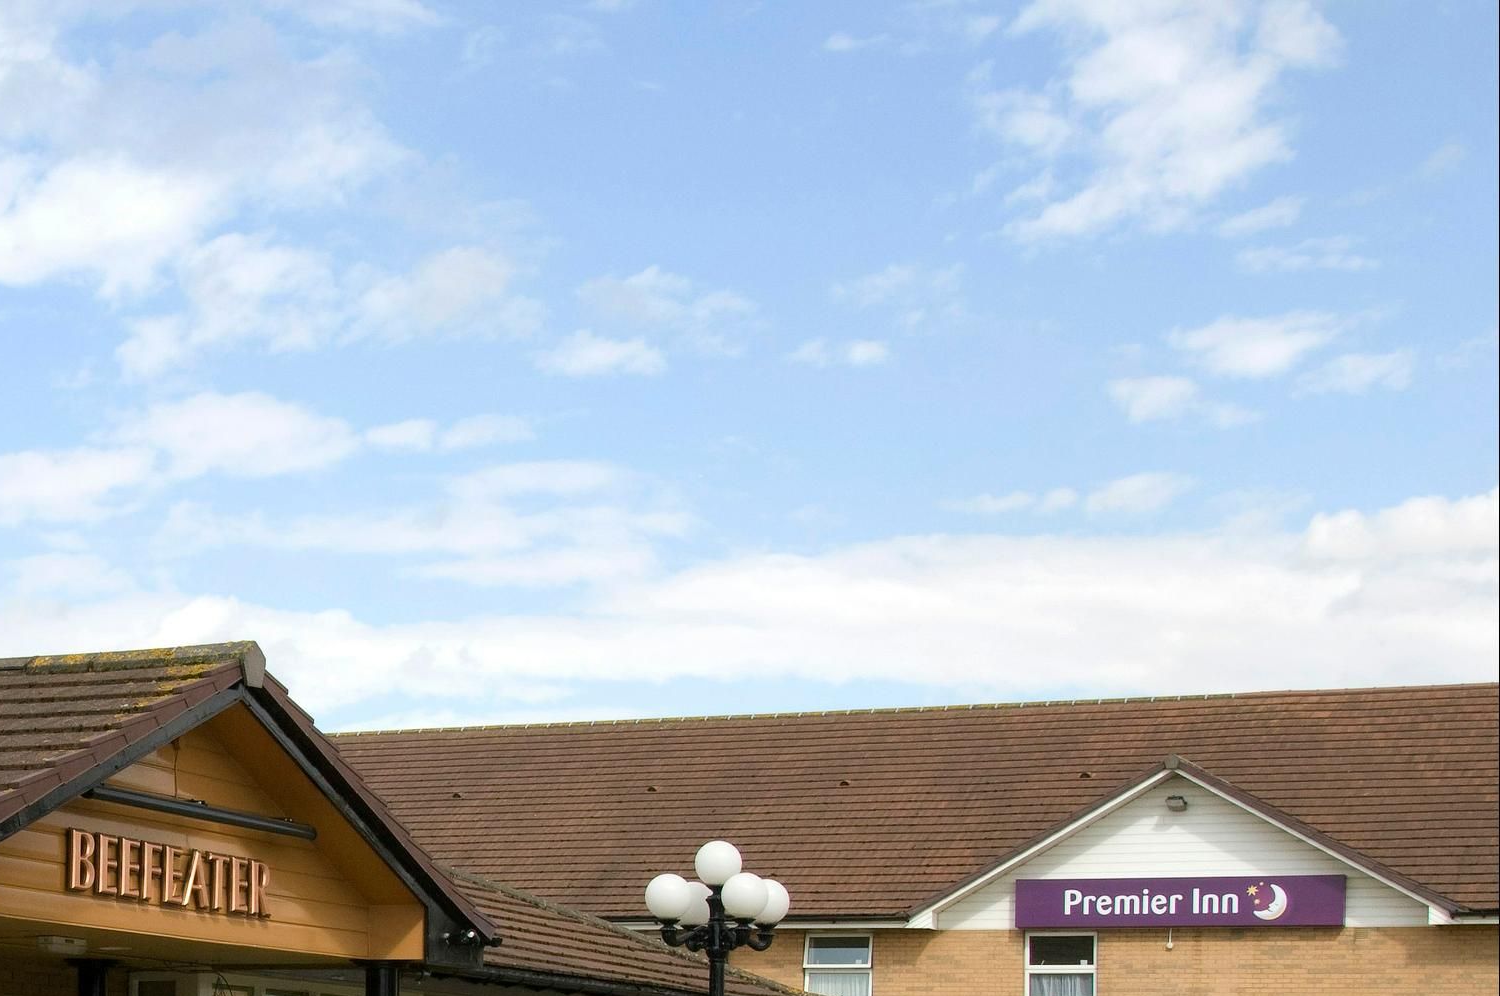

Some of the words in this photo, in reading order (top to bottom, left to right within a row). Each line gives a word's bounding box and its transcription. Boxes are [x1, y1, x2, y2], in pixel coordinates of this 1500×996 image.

[69, 827, 271, 918] BEEFEATER
[1064, 889, 1183, 915] Premier
[1192, 888, 1239, 914] Inn
